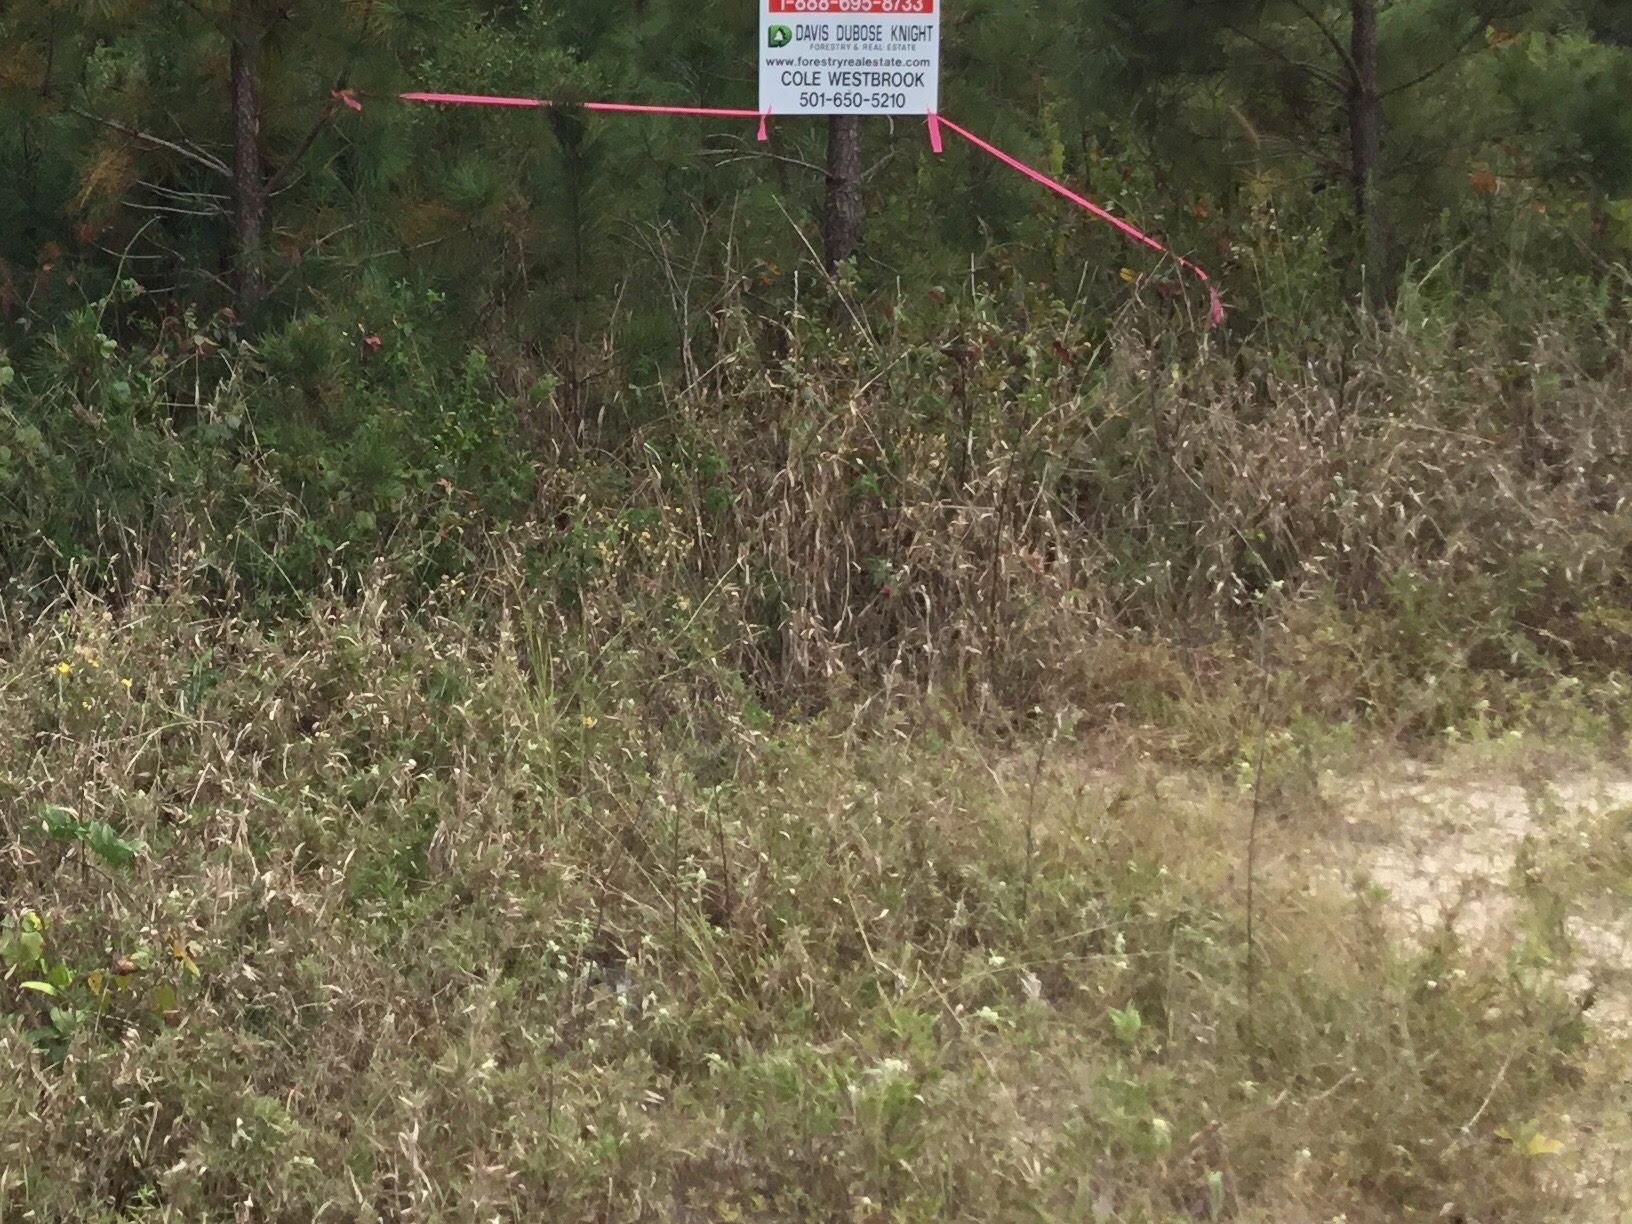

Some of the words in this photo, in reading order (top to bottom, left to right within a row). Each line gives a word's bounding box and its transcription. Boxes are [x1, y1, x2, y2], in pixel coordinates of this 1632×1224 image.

[795, 24, 829, 41] DAVIS
[836, 24, 883, 42] DUBOSE
[891, 25, 934, 42] KNIGHT
[809, 43, 851, 51] FORESTRY
[853, 43, 859, 51] &
[862, 43, 883, 51] REAL
[766, 57, 931, 68] www.forestryrealestate.com
[781, 71, 821, 86] COLE
[828, 72, 925, 87] WESTBROOK
[799, 92, 906, 108] 501-650-5210
